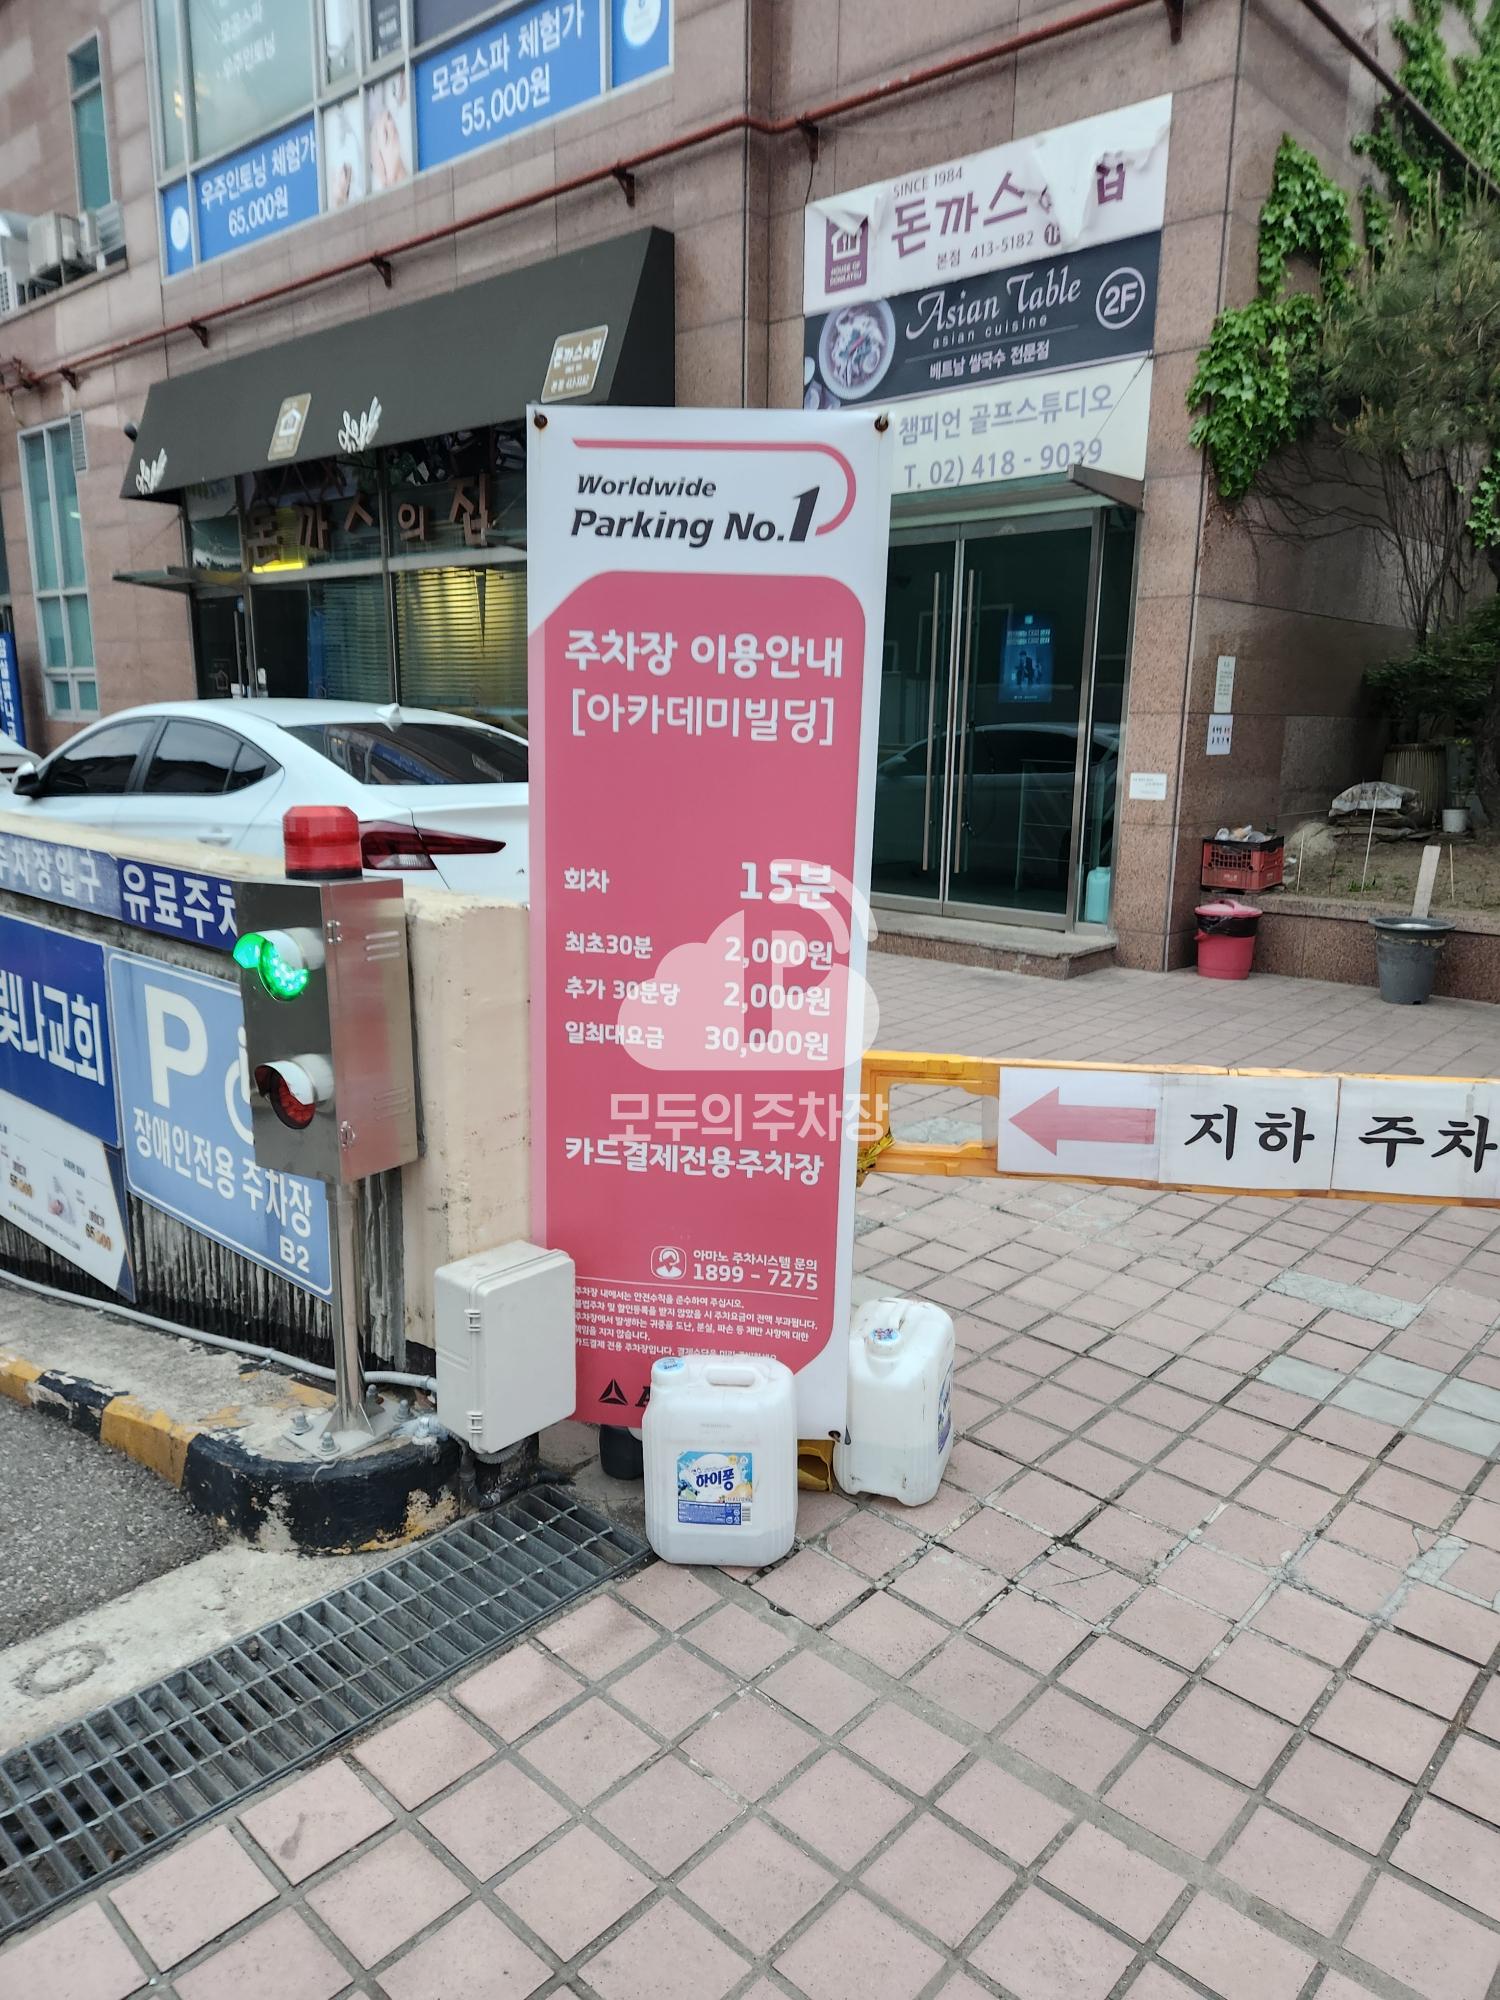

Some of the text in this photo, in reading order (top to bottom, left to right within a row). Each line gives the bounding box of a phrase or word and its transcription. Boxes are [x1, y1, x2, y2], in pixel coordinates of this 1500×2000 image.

[432, 0, 584, 102] 모공스파 체험가
[461, 63, 550, 136] 55,000원
[201, 129, 316, 211] 우주인토닝 체험가
[893, 166, 963, 199] SINCE 1984
[229, 184, 289, 237] 65,000원
[970, 230, 1035, 259] 413-5182
[905, 264, 1082, 341] Asian Table
[1103, 282, 1139, 317] 2F
[932, 314, 1048, 350] asian cuisine
[929, 339, 1050, 380] 베트남 쌀국수 전문점
[899, 384, 1114, 446] 챔피언 골프스튜디오
[577, 474, 717, 498] Worldwide
[904, 464, 921, 489] T.
[930, 455, 964, 486] 02)
[971, 450, 1015, 479] 418
[570, 485, 820, 549] Parking No.1
[565, 629, 843, 680] 주차장 이용안내
[571, 688, 834, 746] [아카데미빌딩]
[563, 861, 836, 911] 회차 15분
[565, 931, 834, 971] 최초30분 2,000원
[565, 976, 831, 1017] 추가 30분당 2,000원
[144, 983, 209, 1109] P
[565, 1021, 829, 1061] 일최대요금 30,000원
[1183, 1103, 1499, 1174] 지하 주차
[133, 1106, 313, 1239] 장애인전용 주차장
[565, 1137, 825, 1186] 카드결제전용주차장
[279, 1234, 311, 1274] B2
[693, 1249, 817, 1272] 아마노 주차시스템 문의
[693, 1263, 744, 1283] 1899
[767, 1269, 818, 1291] 7275
[695, 1467, 735, 1492] 하이퐁
